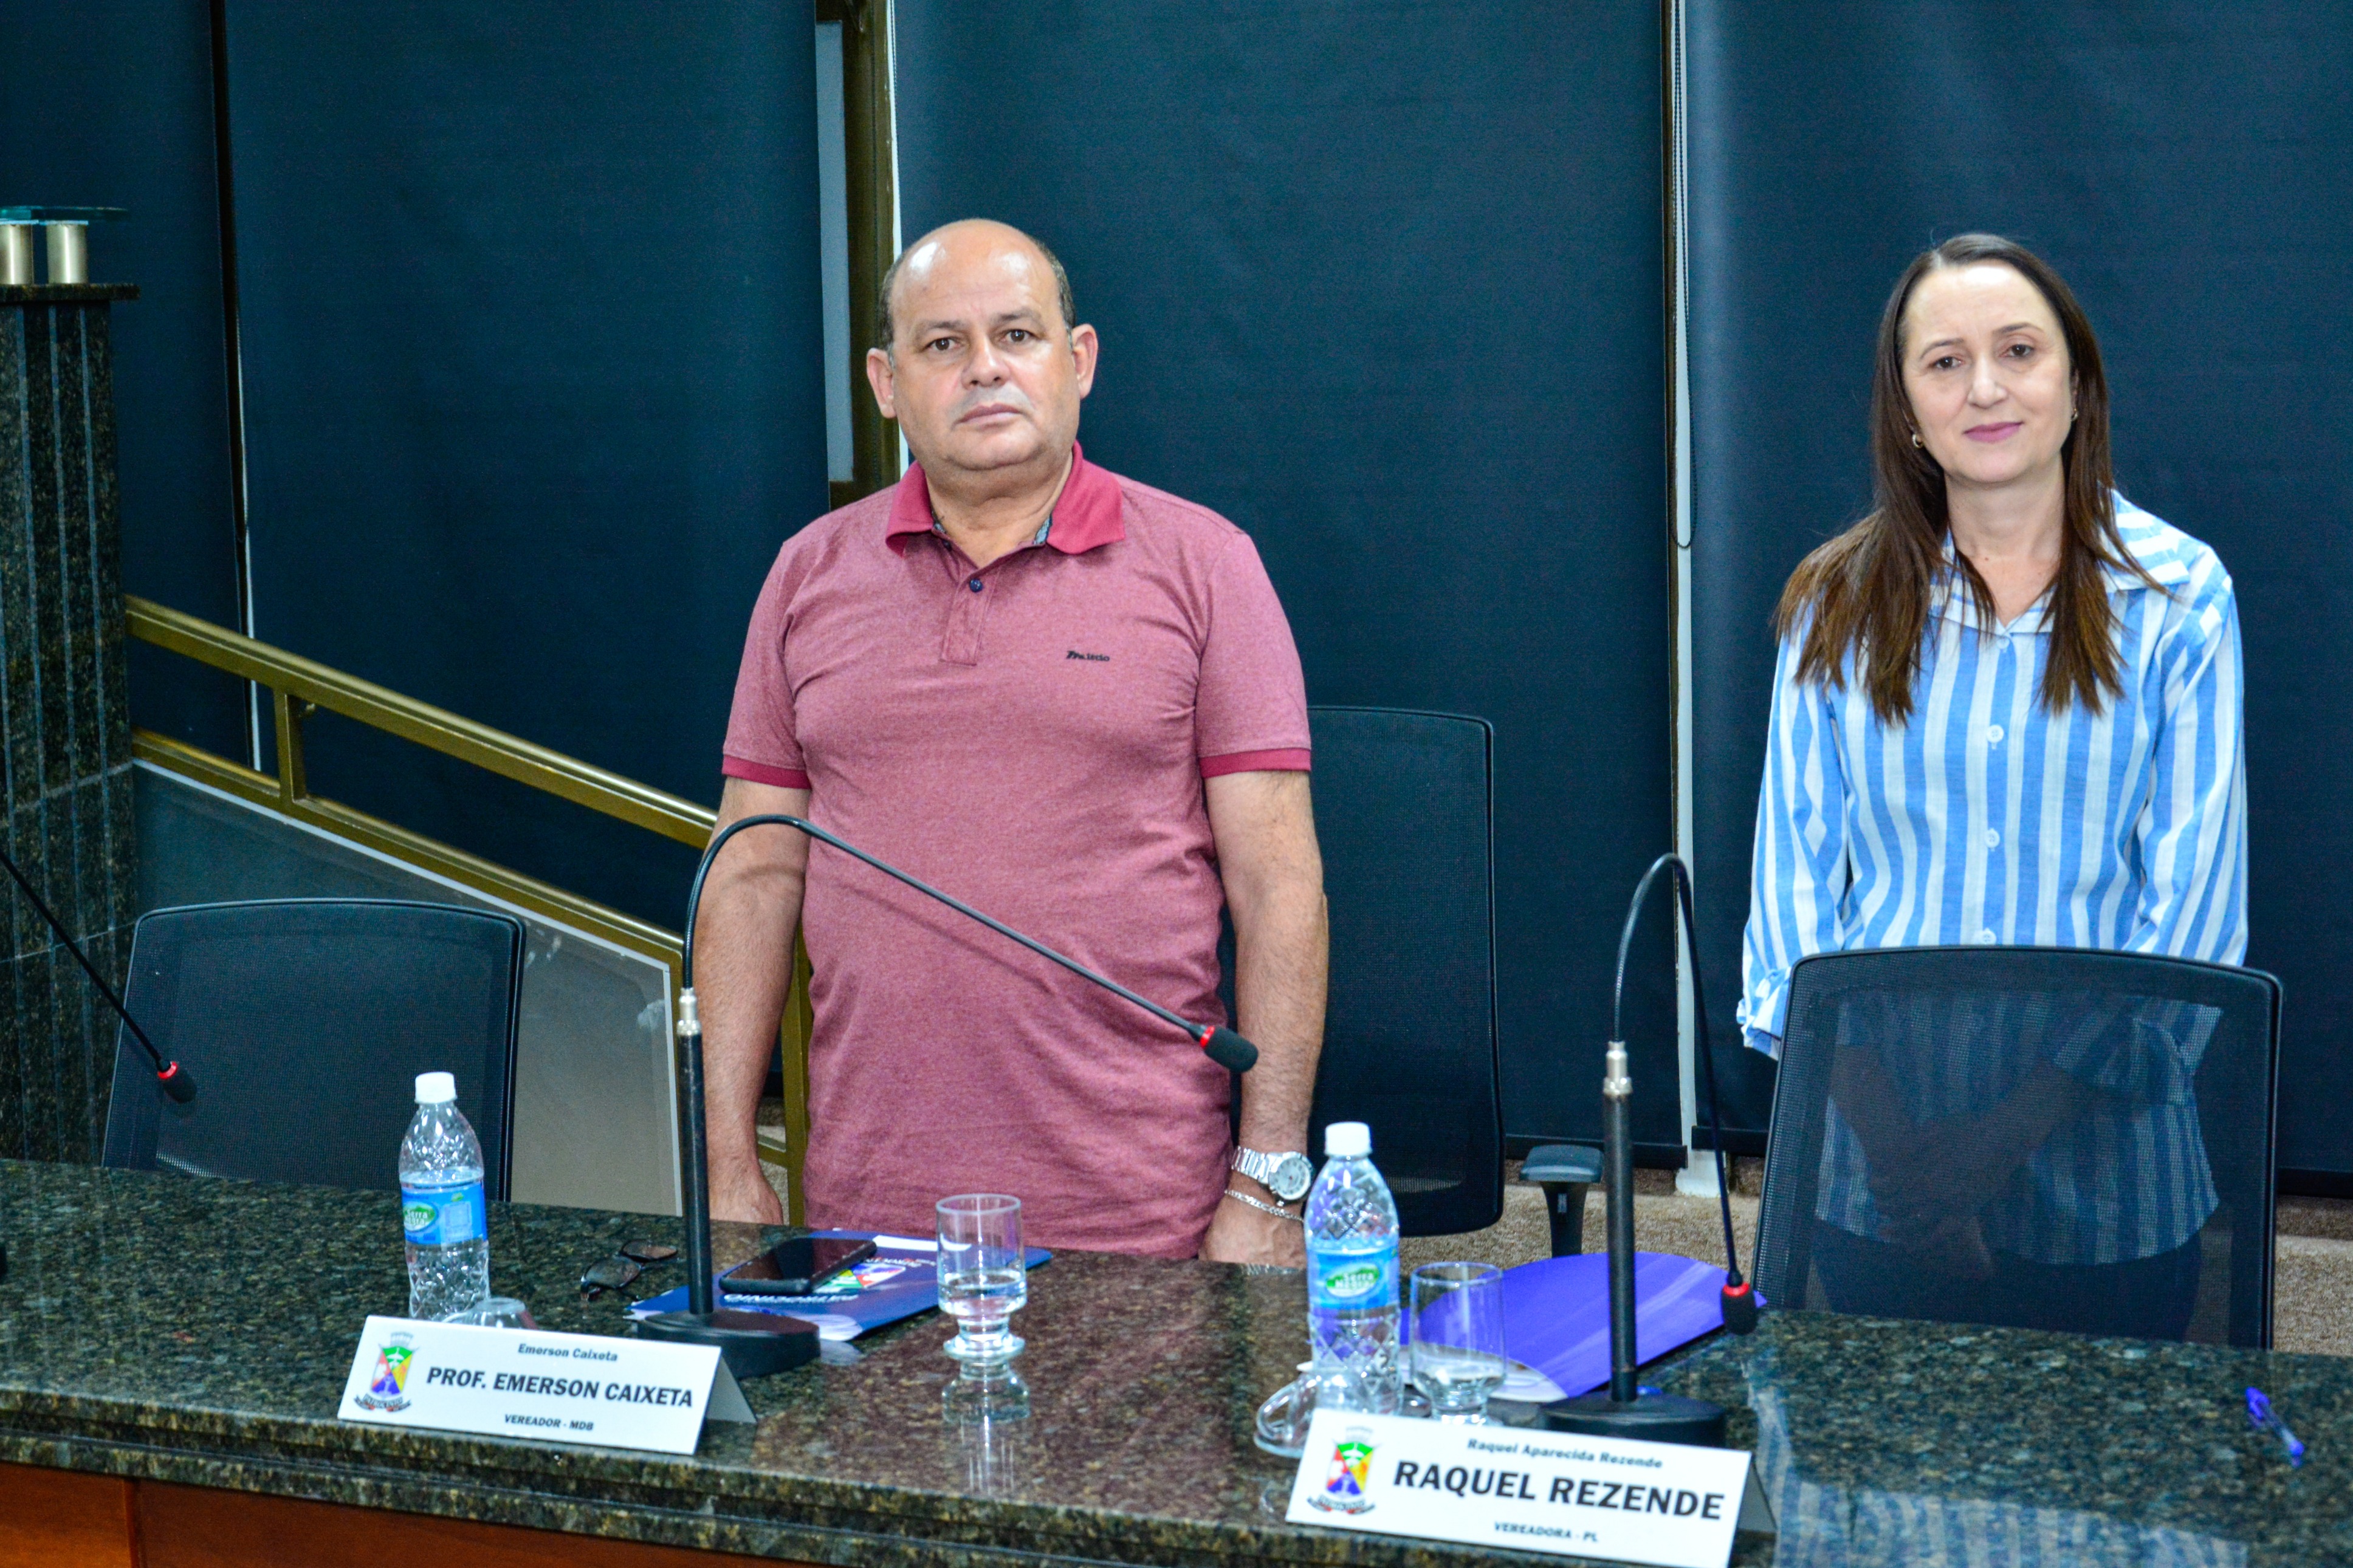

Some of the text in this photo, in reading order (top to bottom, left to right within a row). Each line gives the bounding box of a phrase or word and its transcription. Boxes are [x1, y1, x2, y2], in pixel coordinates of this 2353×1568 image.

[518, 1343, 618, 1361] Emerson Caixeta
[427, 1367, 693, 1407] PROF. EMERSON CAIXETA
[505, 1414, 562, 1428] VEREADOR
[569, 1420, 594, 1430] MDB
[1468, 1438, 1663, 1468] Raquel Aparecida Rezende
[1394, 1460, 1725, 1519] RAQUEL REZENDE
[1495, 1522, 1572, 1538] VEREADORA
[1583, 1532, 1598, 1542] PL
